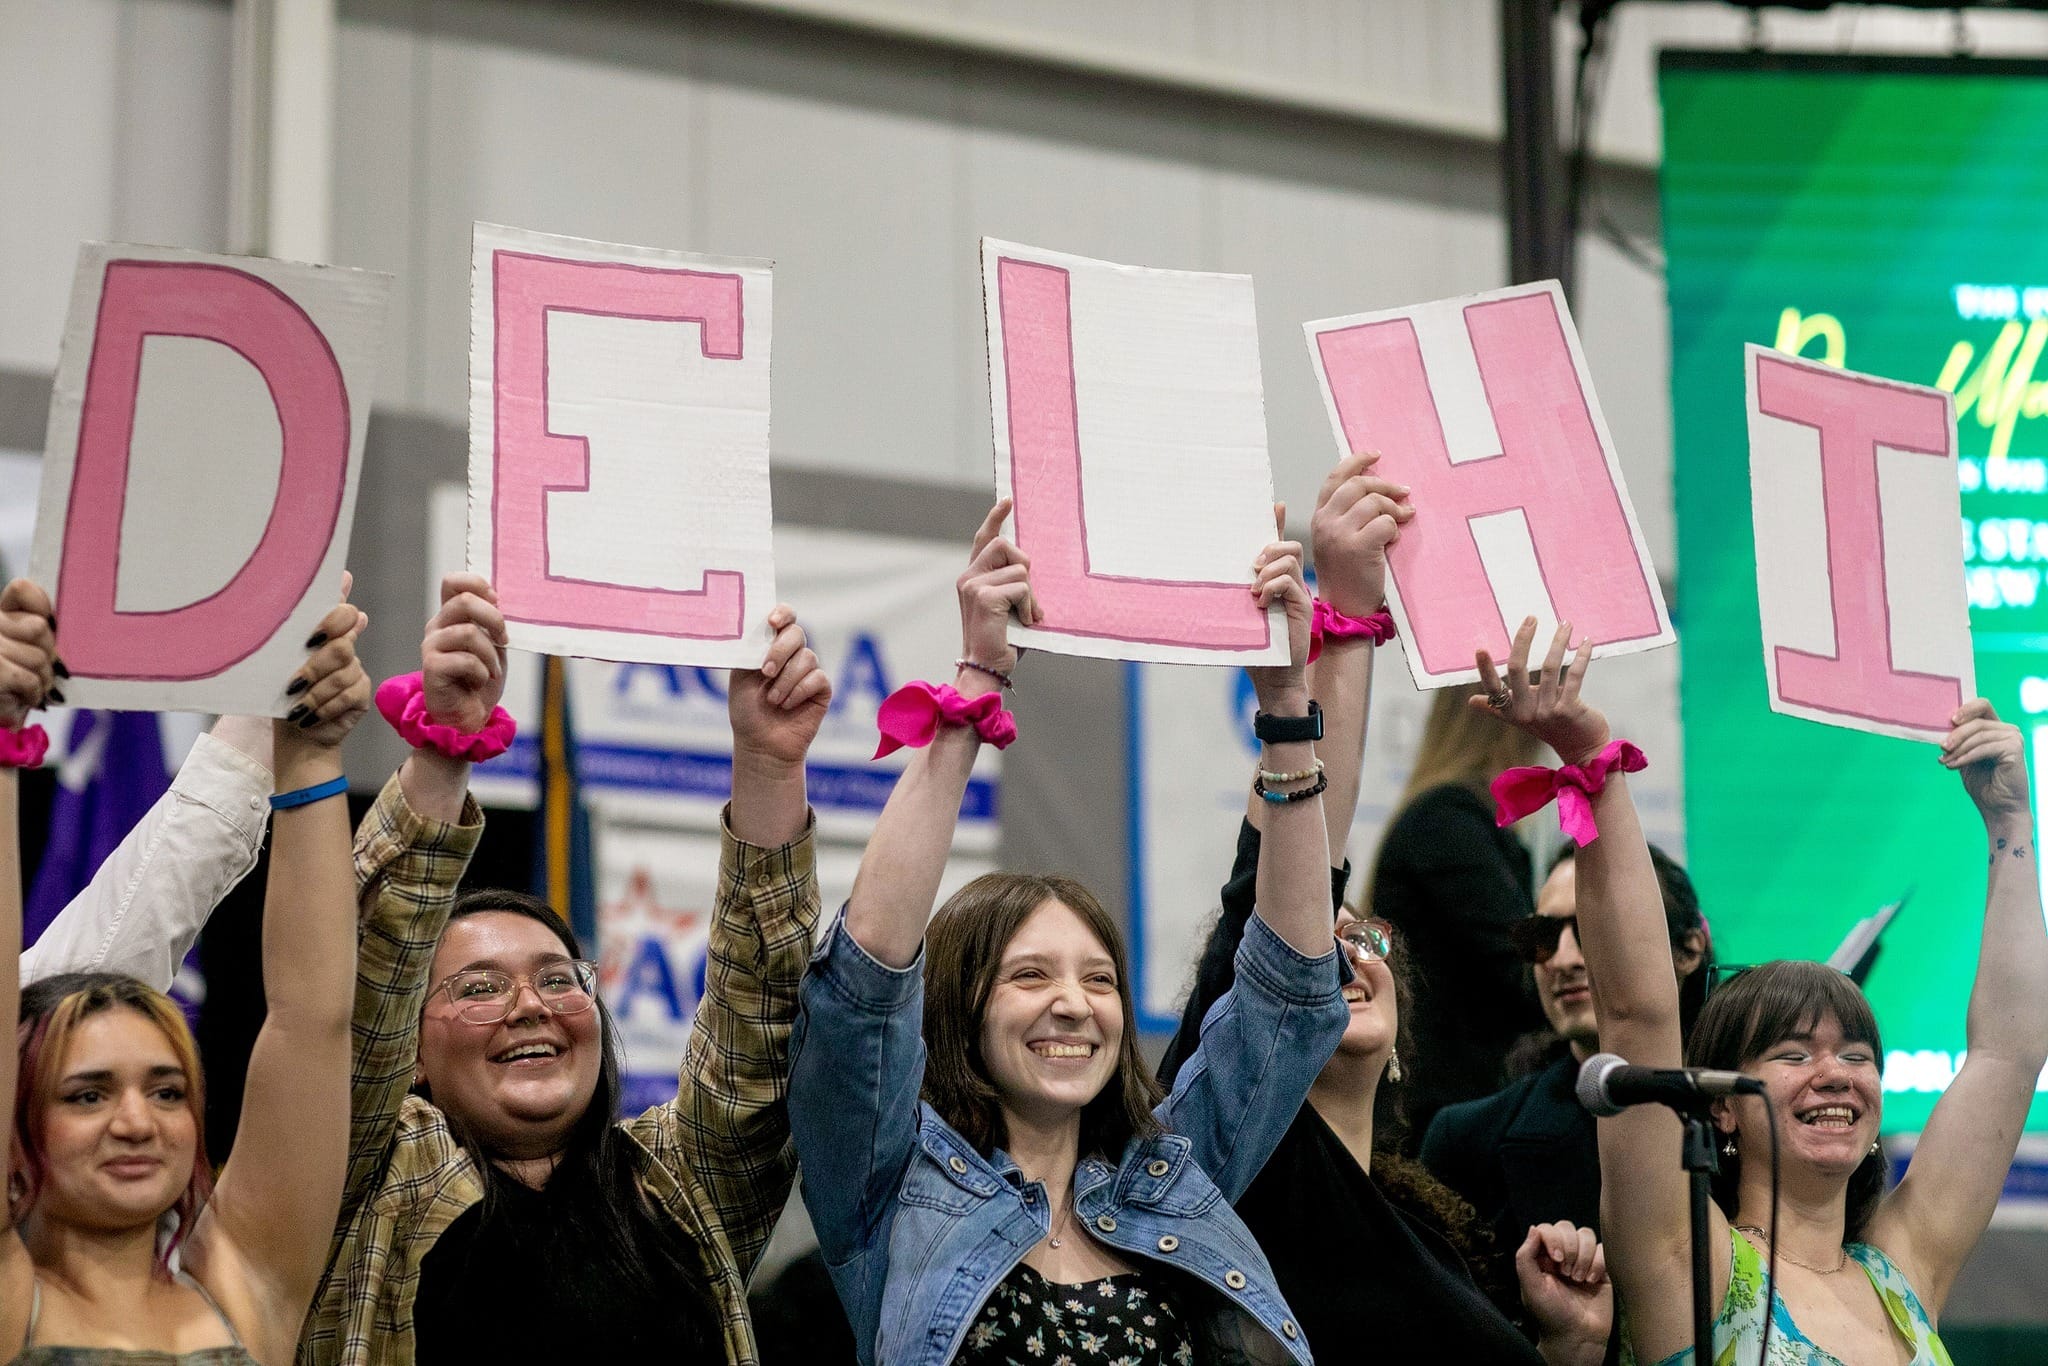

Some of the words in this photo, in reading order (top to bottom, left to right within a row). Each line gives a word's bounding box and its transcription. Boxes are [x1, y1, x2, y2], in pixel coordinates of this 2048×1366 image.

[56, 259, 351, 682] D
[491, 249, 745, 640] E
[997, 256, 1271, 651] L
[1316, 291, 1663, 675] H
[1757, 353, 1964, 732] I
